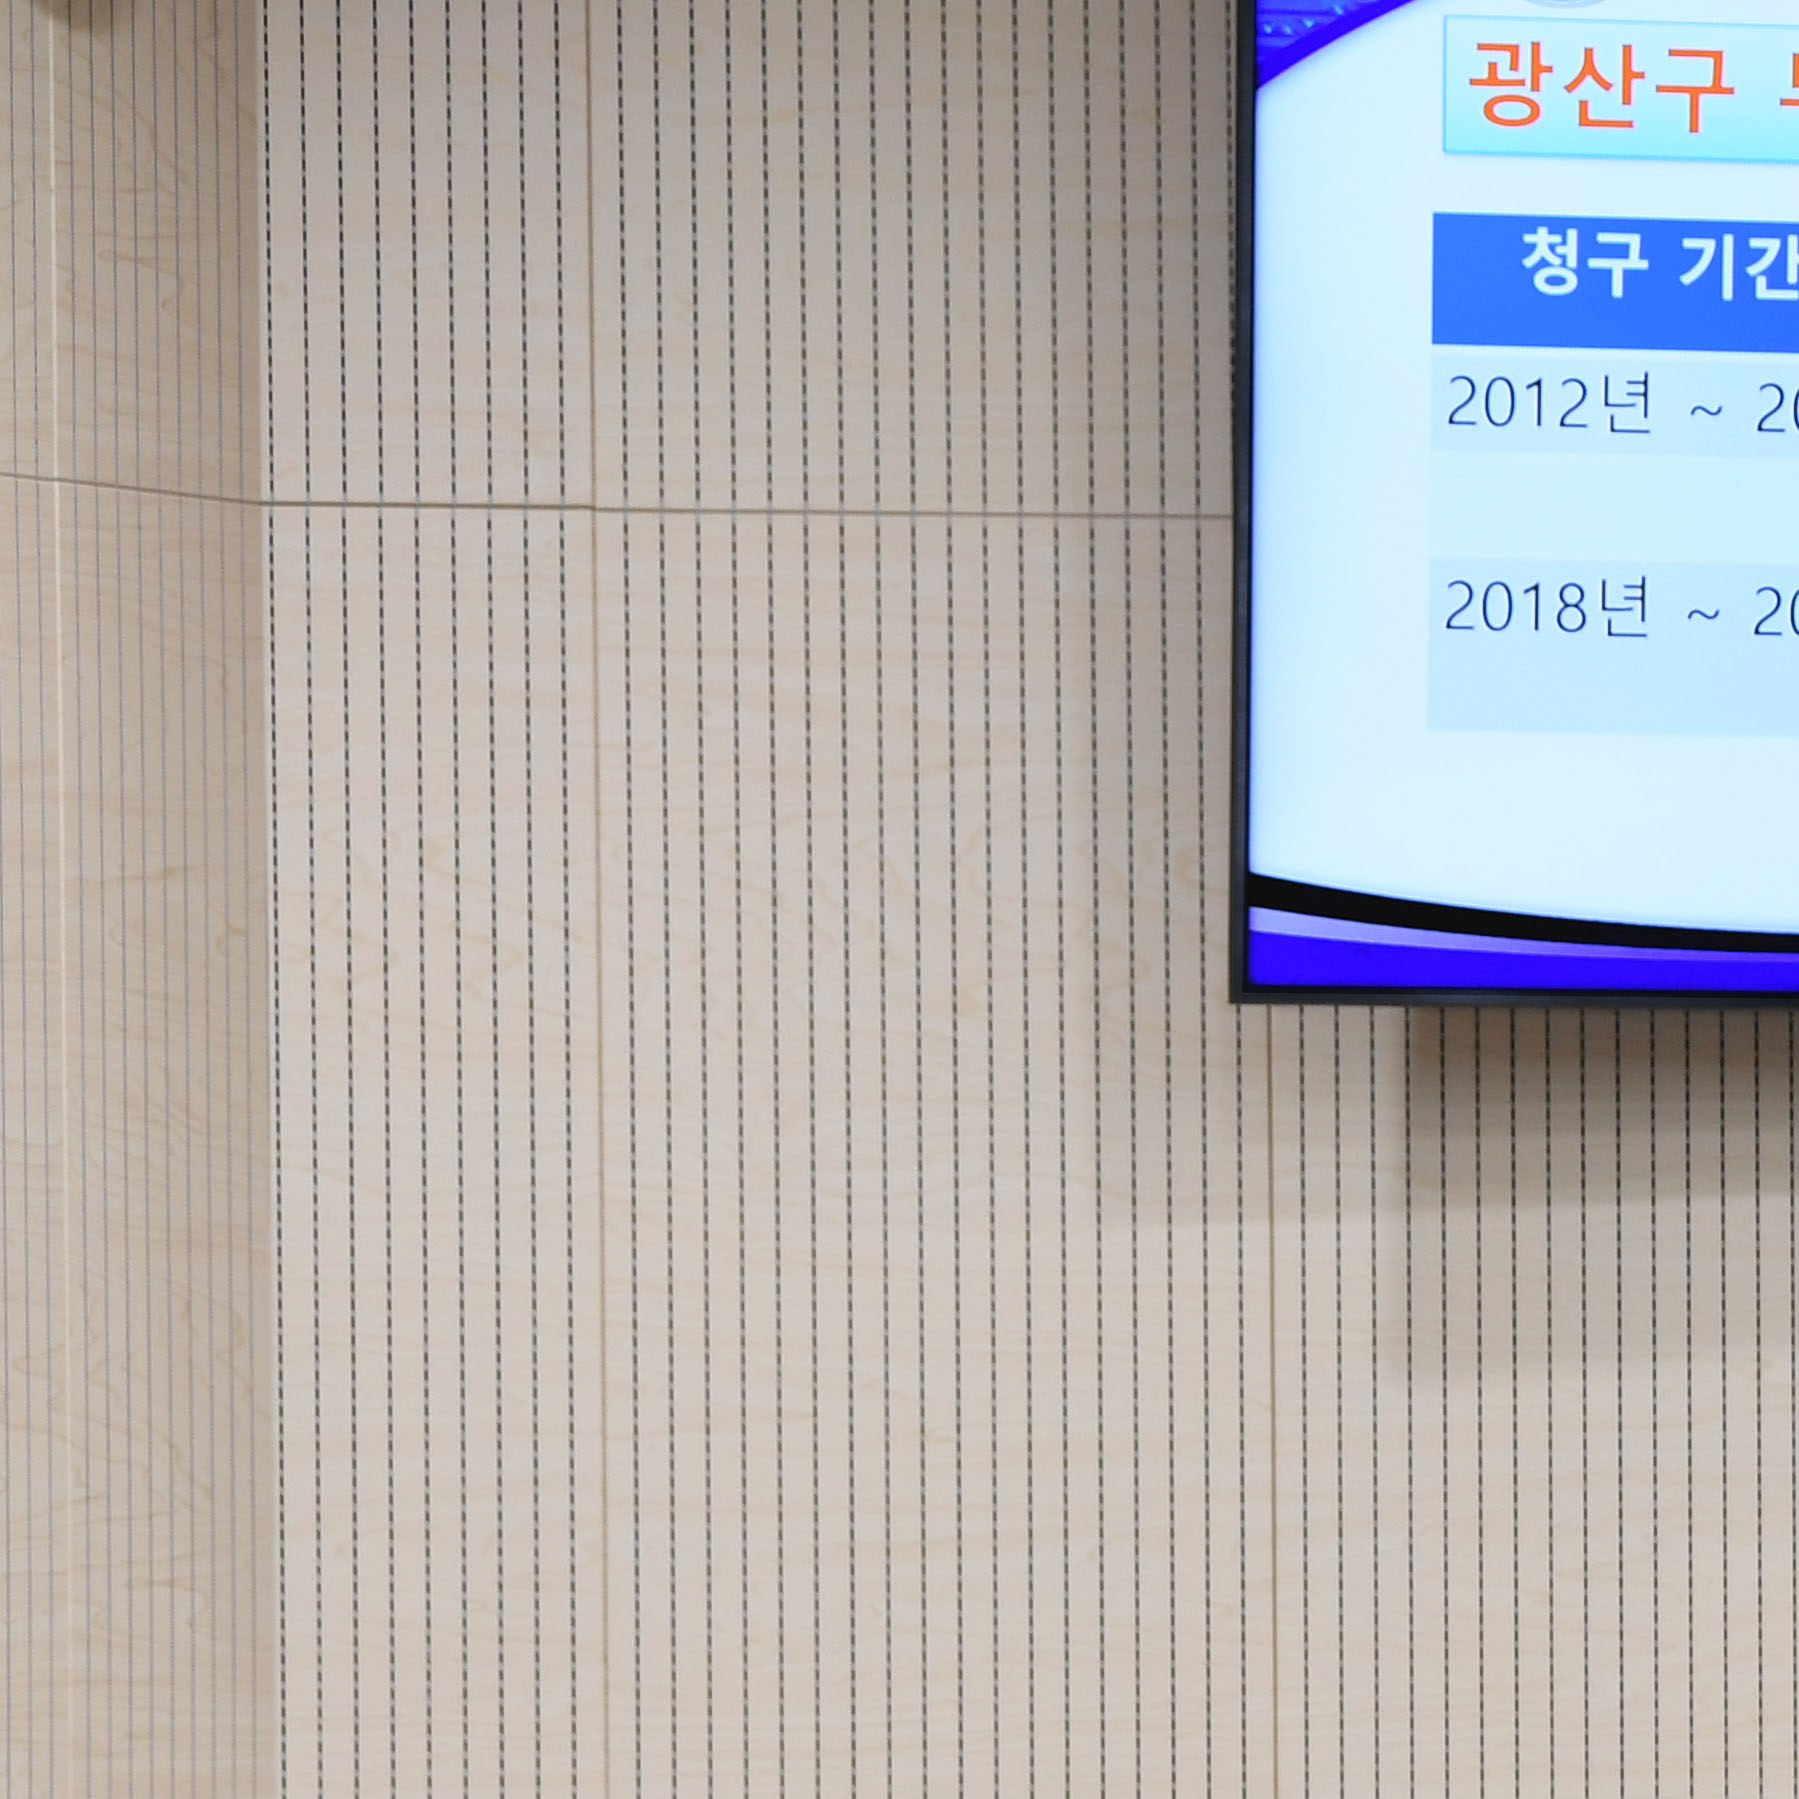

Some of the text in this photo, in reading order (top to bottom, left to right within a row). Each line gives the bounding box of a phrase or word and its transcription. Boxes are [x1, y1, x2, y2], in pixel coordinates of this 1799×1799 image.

[1469, 41, 1736, 133] 광산구
[1522, 227, 1650, 298] 청구
[1447, 370, 1652, 436] 2012년
[1445, 575, 1649, 639] 2018년
